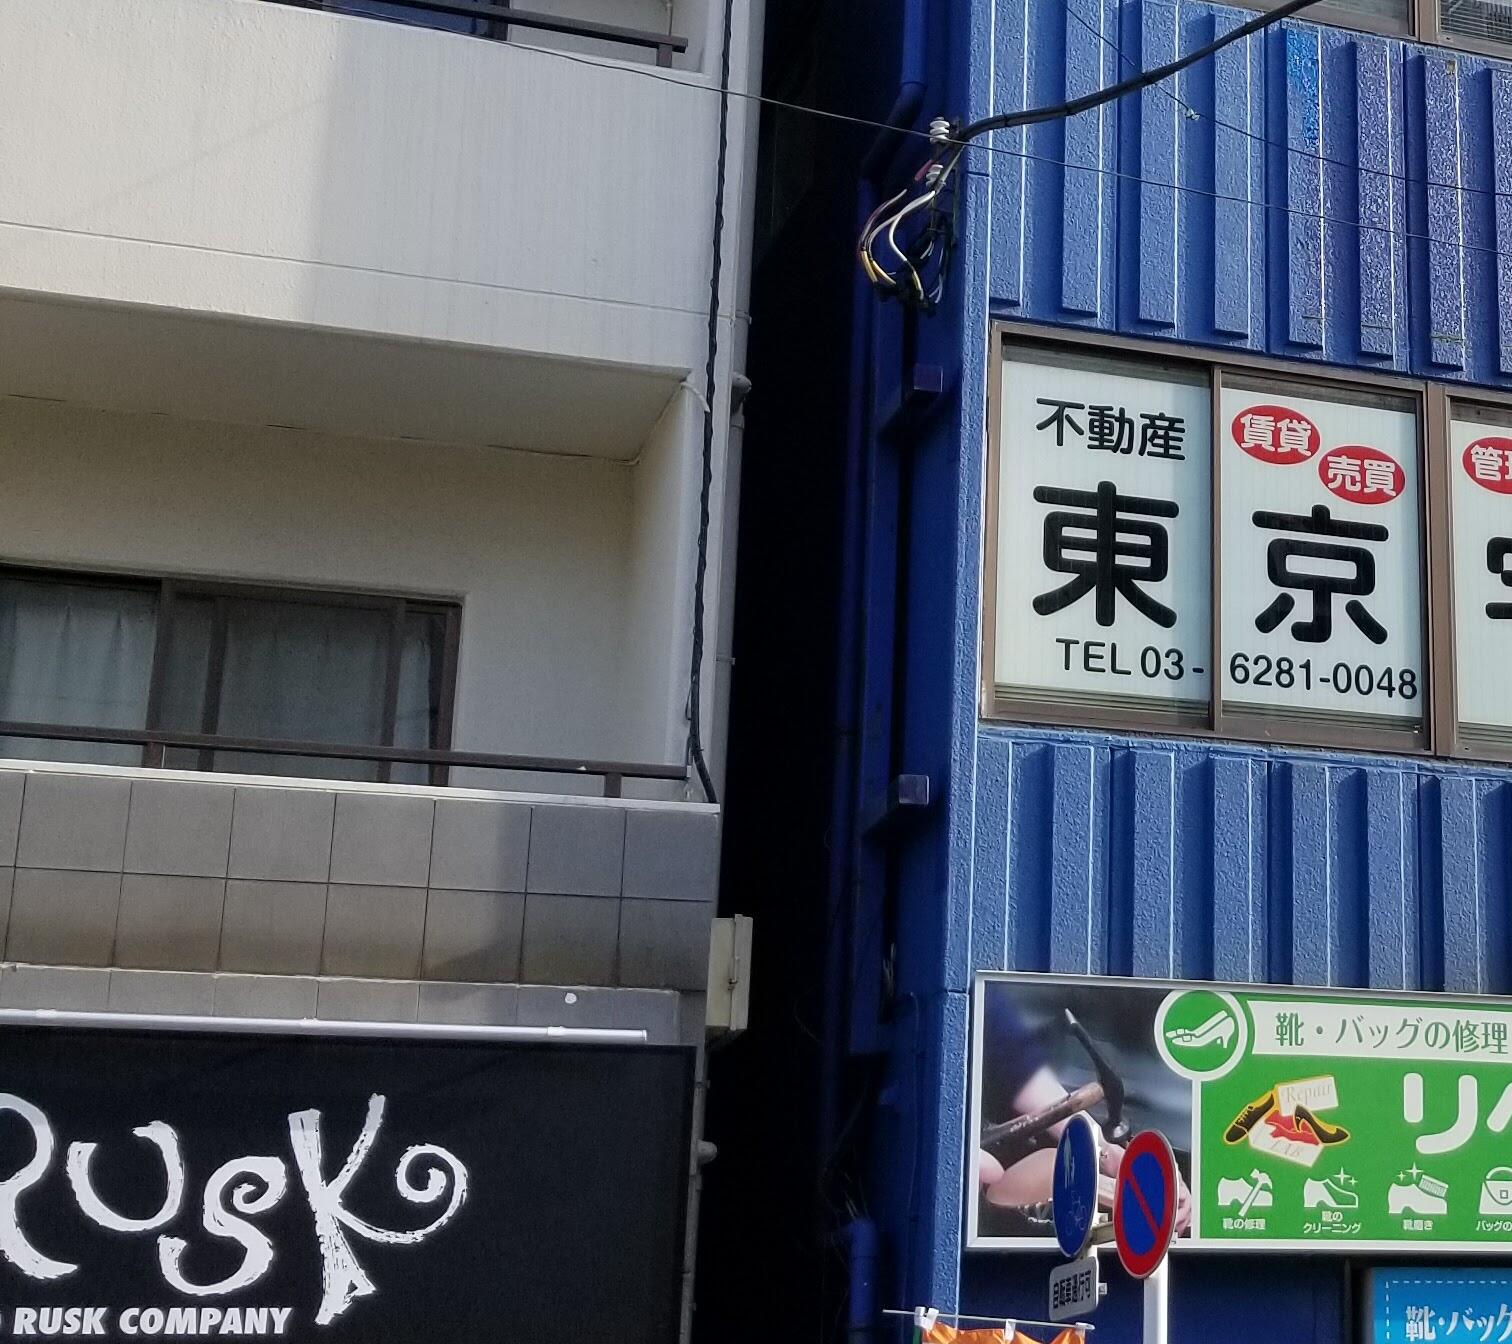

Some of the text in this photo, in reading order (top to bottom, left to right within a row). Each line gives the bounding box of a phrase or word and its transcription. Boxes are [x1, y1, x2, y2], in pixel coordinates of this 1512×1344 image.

[1035, 397, 1186, 461] 不動産
[1240, 413, 1312, 456] 賃貸
[1326, 454, 1397, 497] 売買
[1055, 637, 1132, 676] TEL
[1229, 652, 1419, 700] 6281-0048
[1303, 1222, 1361, 1234] クリーニング
[12, 1307, 292, 1335] RUSK COMPANY
